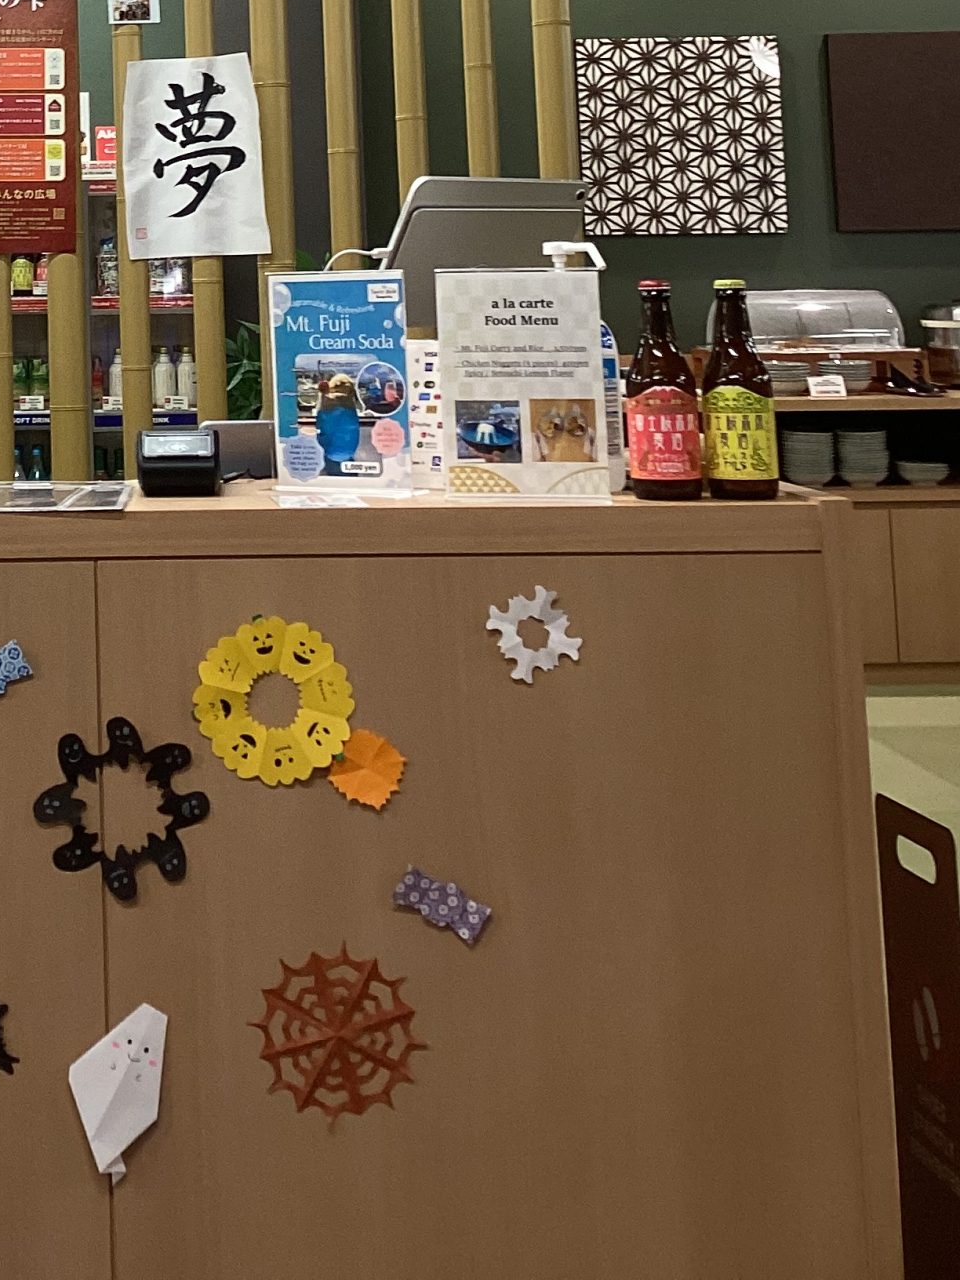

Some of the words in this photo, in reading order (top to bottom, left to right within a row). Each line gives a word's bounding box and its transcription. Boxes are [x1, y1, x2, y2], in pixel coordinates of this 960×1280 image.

[153, 72, 247, 218] 夢
[491, 299, 499, 309] a
[503, 298, 516, 309] la
[519, 298, 554, 309] carte
[286, 315, 314, 333] Mt.
[319, 314, 351, 336] Fuji
[484, 315, 517, 326] Food
[520, 315, 559, 326] Menu
[308, 334, 356, 351] Cream
[358, 333, 394, 350] Soda
[364, 464, 377, 472] yen
